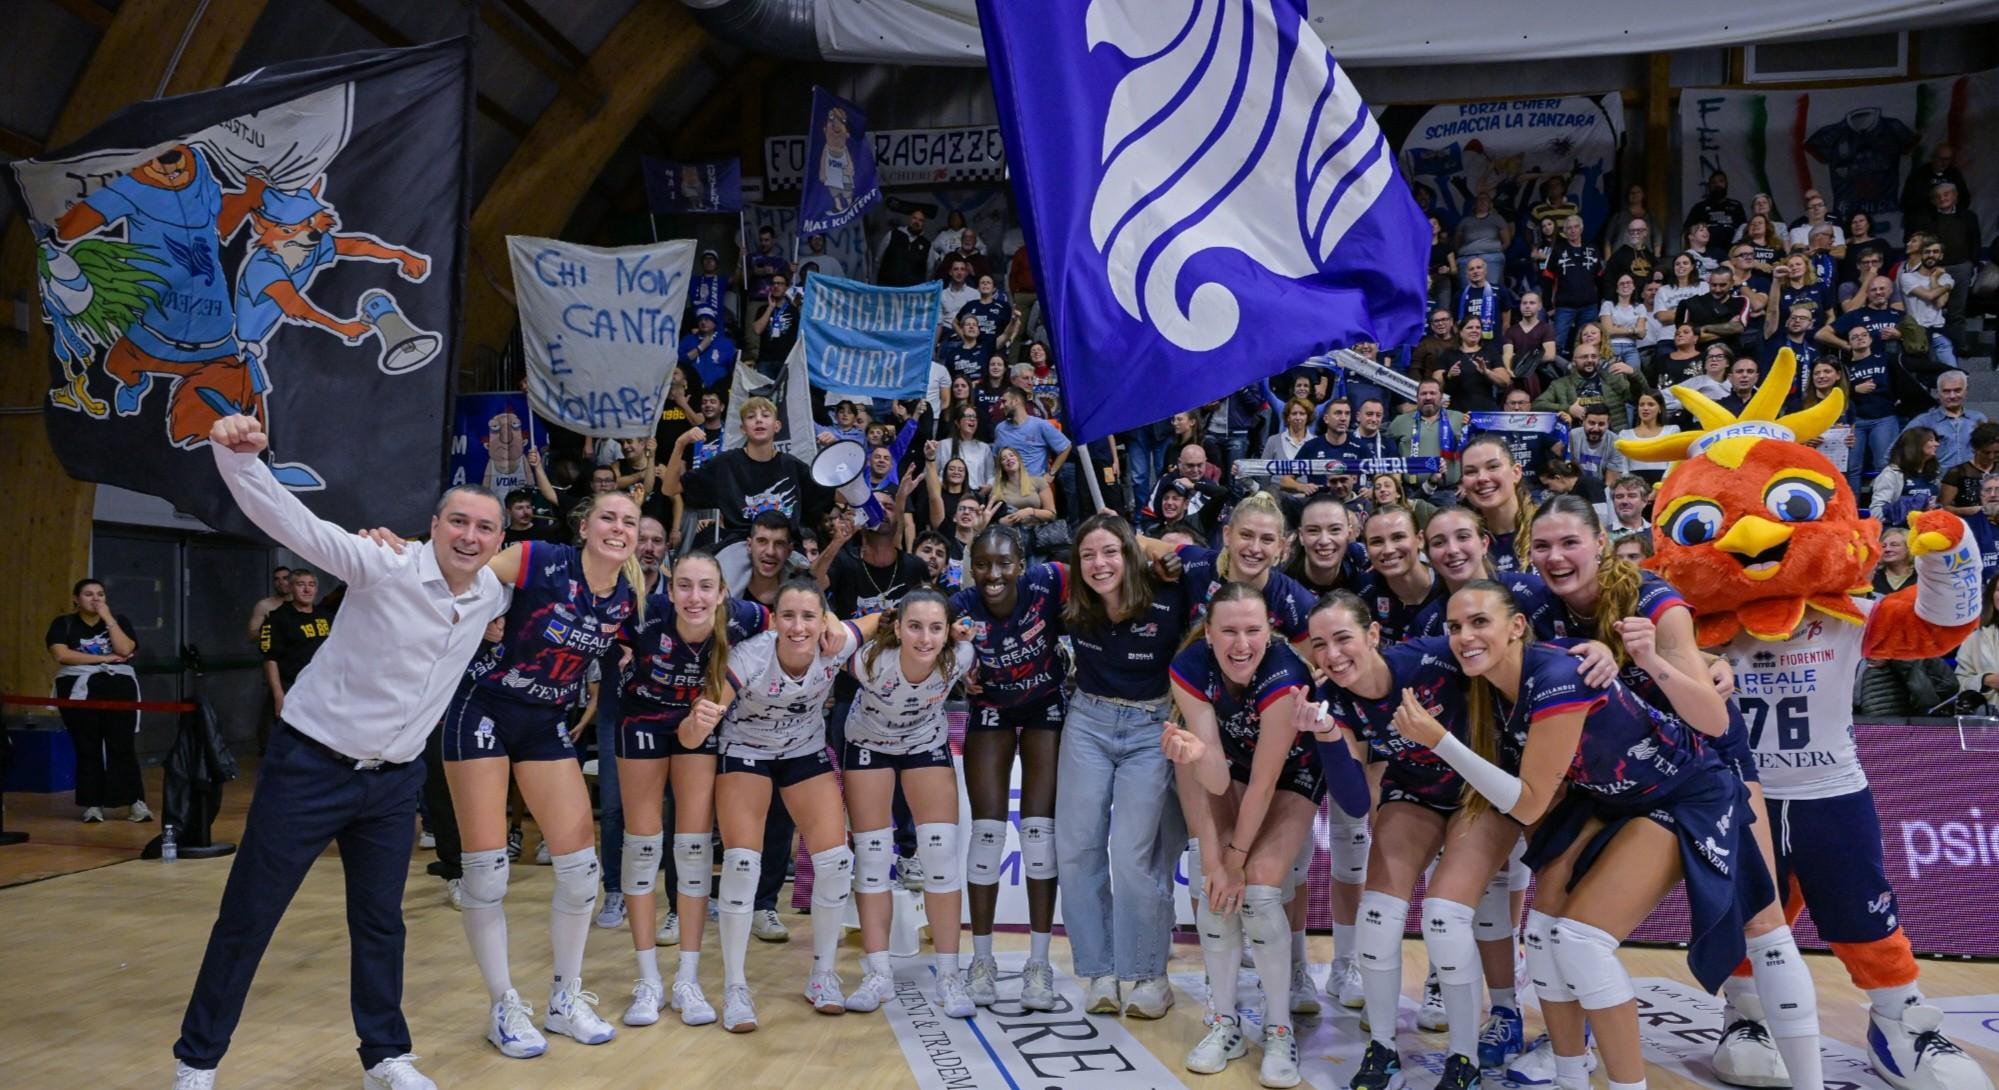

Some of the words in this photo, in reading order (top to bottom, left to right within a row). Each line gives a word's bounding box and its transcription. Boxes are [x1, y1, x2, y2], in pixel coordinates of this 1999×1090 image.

[1460, 101, 1507, 116] FORZA
[1425, 116, 1500, 139] SCHIACCIA
[1505, 113, 1523, 128] LA
[1528, 112, 1595, 128] ZANZARA
[875, 129, 1003, 166] RAGAZZE
[535, 249, 588, 287] CHI
[616, 254, 682, 296] NON
[810, 282, 935, 331] BRIGANTI
[562, 303, 677, 348] CANTA
[821, 344, 909, 388] CHIERI
[1726, 425, 1791, 441] REALE
[1359, 457, 1408, 475] CHIERI
[1000, 634, 1046, 664] REALE
[1780, 649, 1835, 666] FIORENTINI
[1744, 669, 1817, 686] REALE
[1746, 684, 1816, 695] MUTUA
[981, 709, 1000, 726] 12
[1738, 696, 1811, 750] 76
[635, 731, 655, 750] 11
[858, 748, 872, 766] 8
[894, 979, 936, 1018] PATENT
[911, 1019, 941, 1030] &
